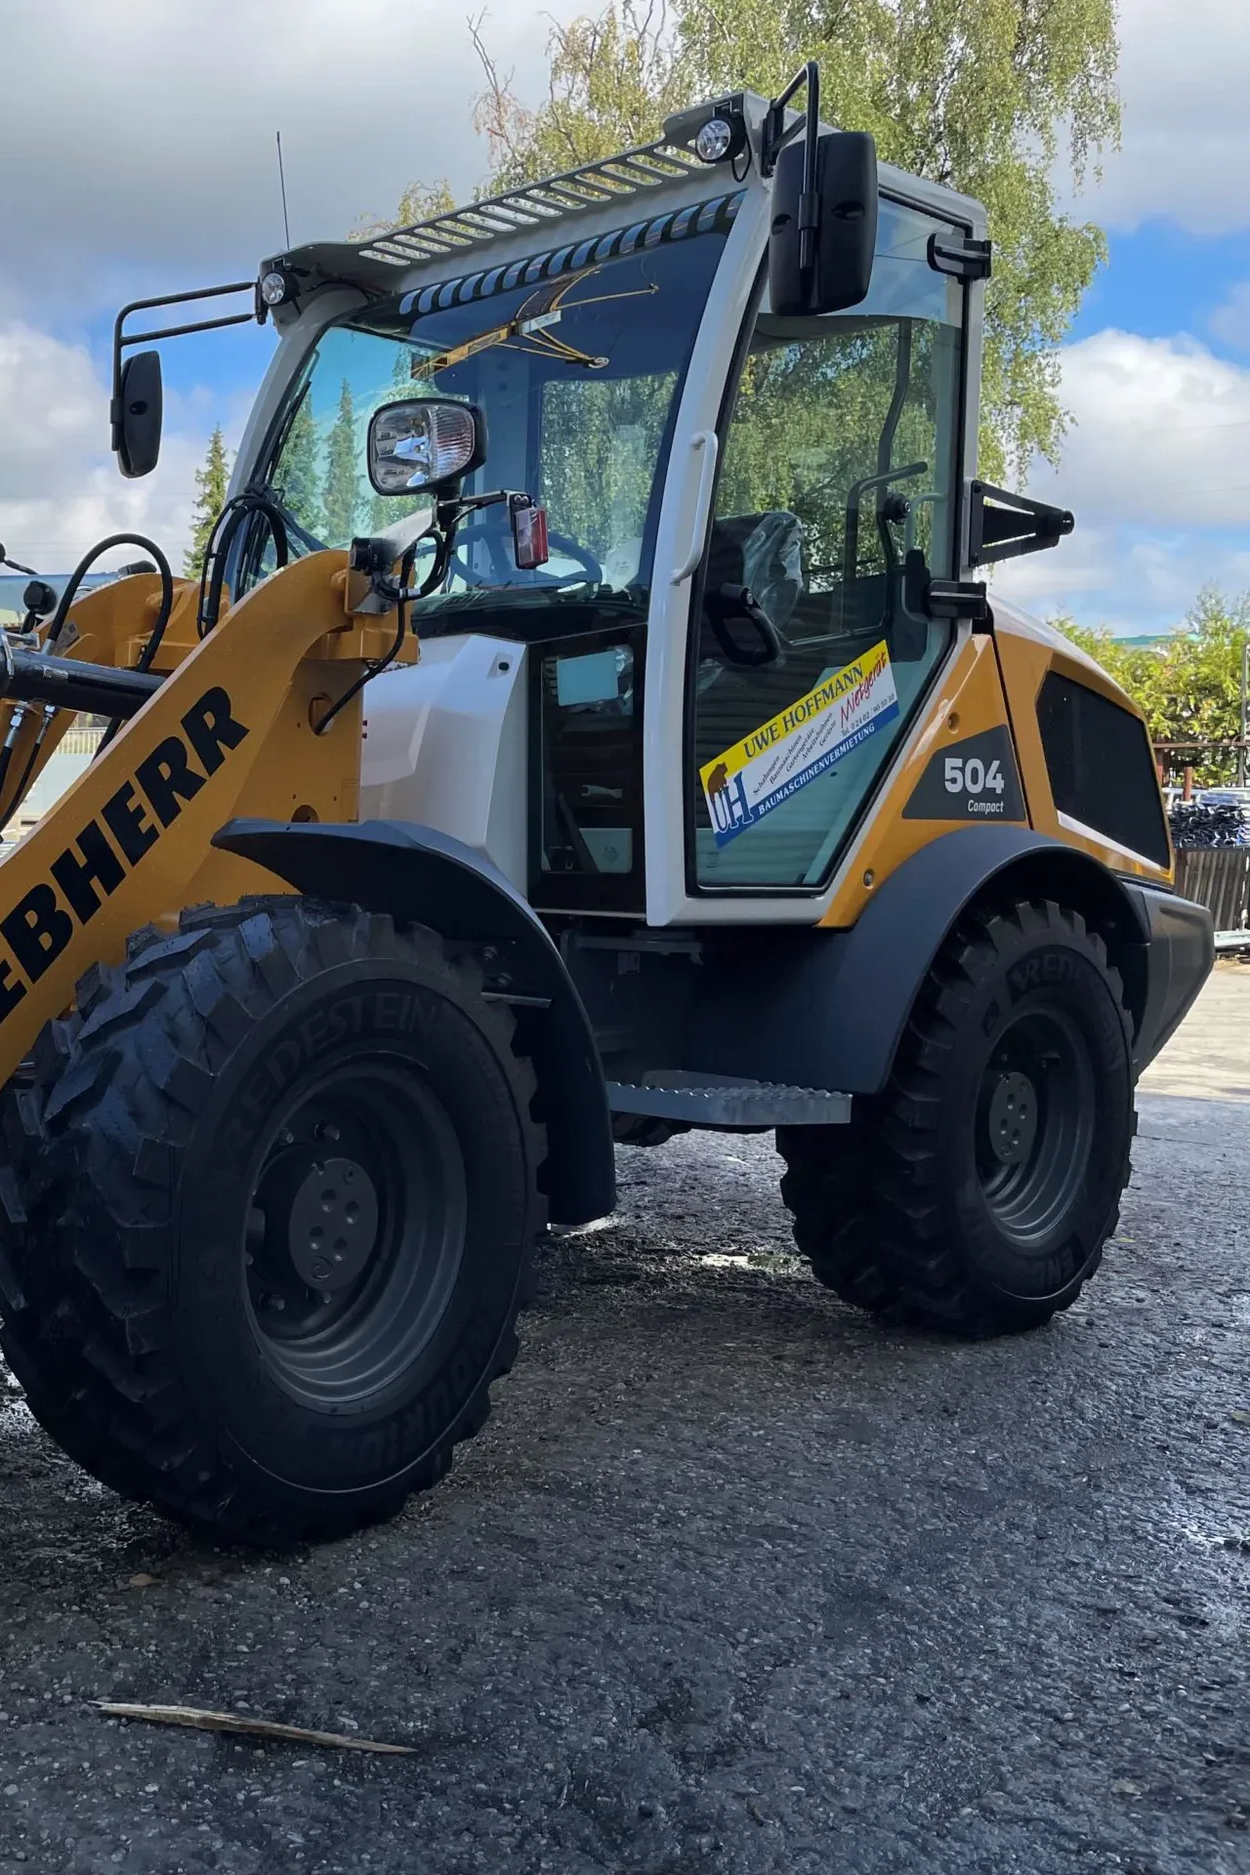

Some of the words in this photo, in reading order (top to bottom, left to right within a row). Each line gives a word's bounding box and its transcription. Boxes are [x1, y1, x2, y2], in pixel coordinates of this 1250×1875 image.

[743, 726, 781, 759] UWE
[782, 662, 864, 733] HOFFMANN
[840, 650, 888, 728] Mietgerät
[770, 734, 803, 785] Baumaschinen
[786, 727, 815, 772] Gartengeräte
[802, 711, 833, 760] Arbeitsbühnen
[753, 755, 781, 796] Schalungen
[758, 722, 876, 816] BAUMASCHINENVERMIETUNG
[944, 757, 1005, 794] 504
[967, 799, 1004, 815] Compact
